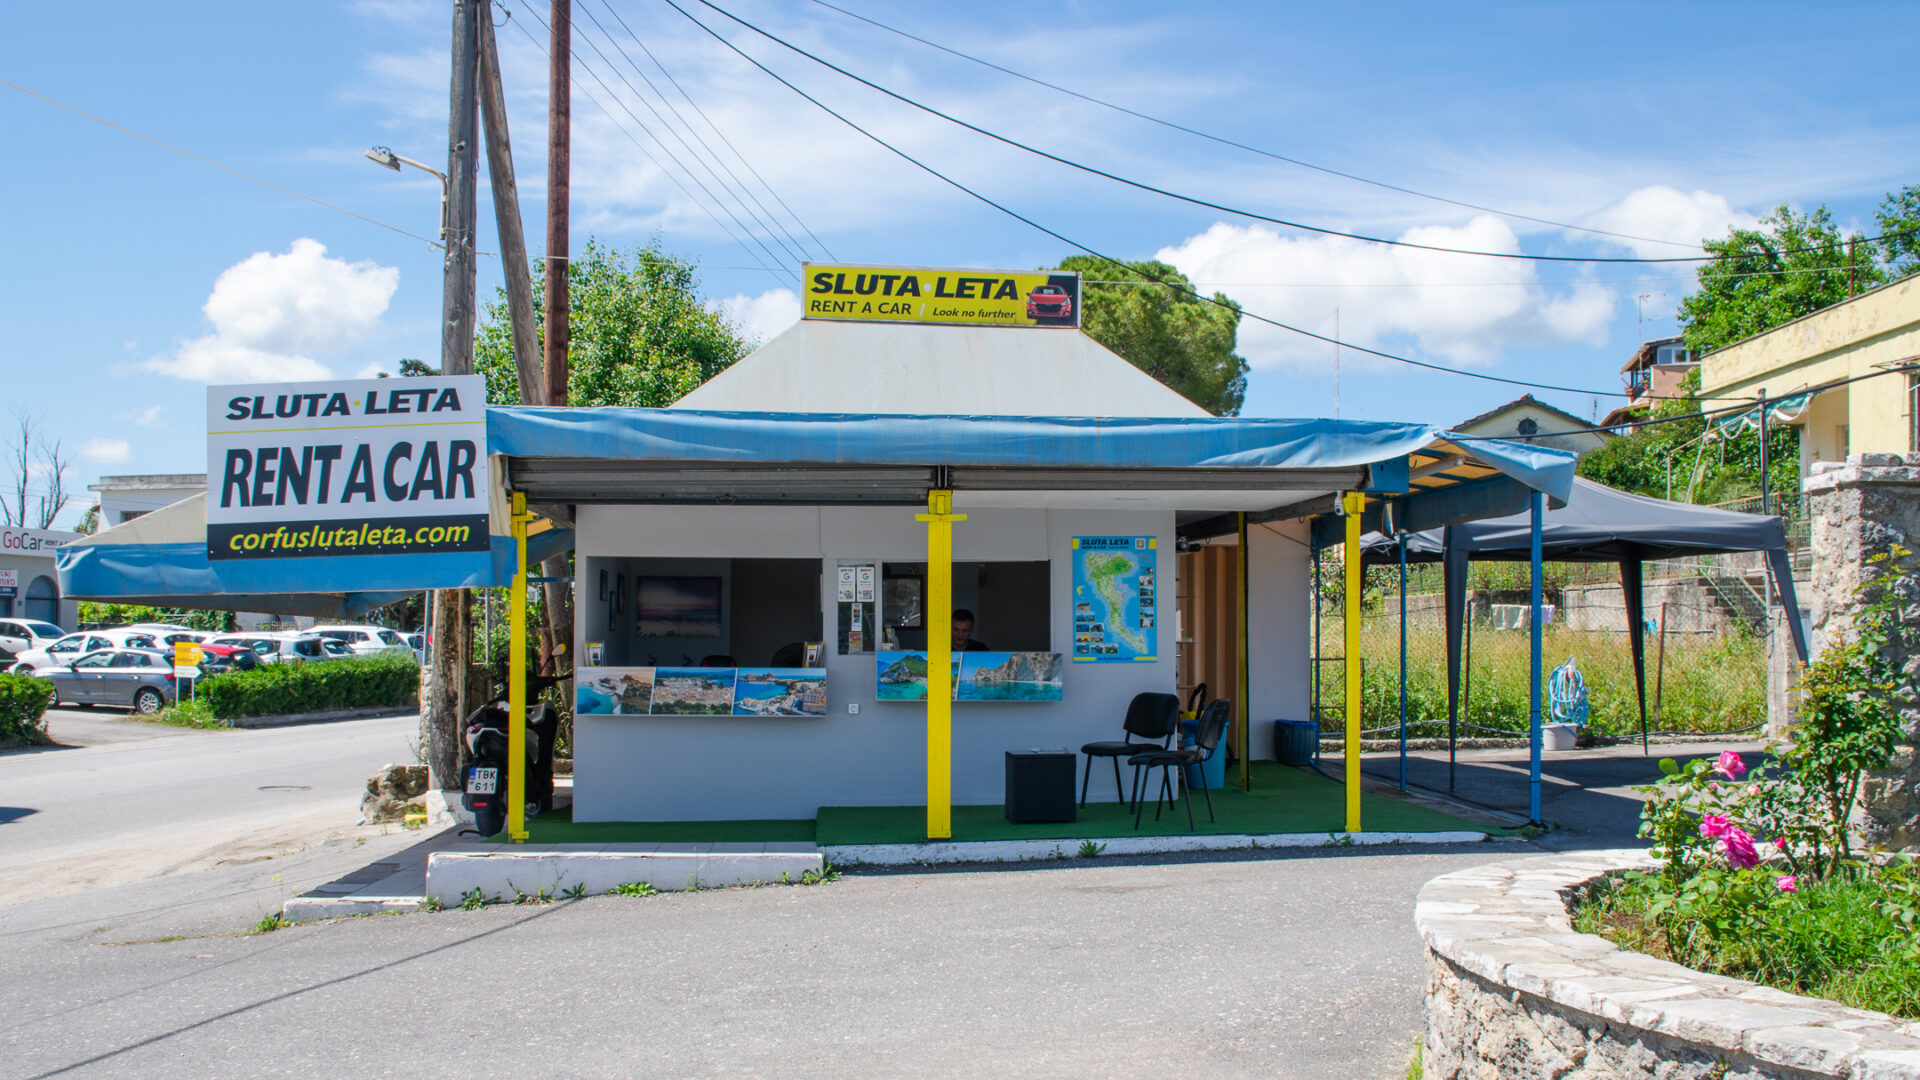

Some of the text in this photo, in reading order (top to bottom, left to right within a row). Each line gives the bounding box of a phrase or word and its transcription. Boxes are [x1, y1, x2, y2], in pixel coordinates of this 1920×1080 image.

[811, 273, 1018, 300] SLUTA LETA
[811, 300, 911, 315] RENT A CAR
[933, 307, 959, 316] Look
[977, 308, 1016, 319] further
[225, 388, 462, 421] SLUTA LETA
[220, 439, 477, 508] RENT A CAR
[3, 530, 44, 551] GoCar
[229, 523, 470, 551] corfuslutaleta.com
[1081, 538, 1130, 546] SLUTA LETA
[477, 770, 496, 780] TBK
[475, 782, 495, 792] 611
